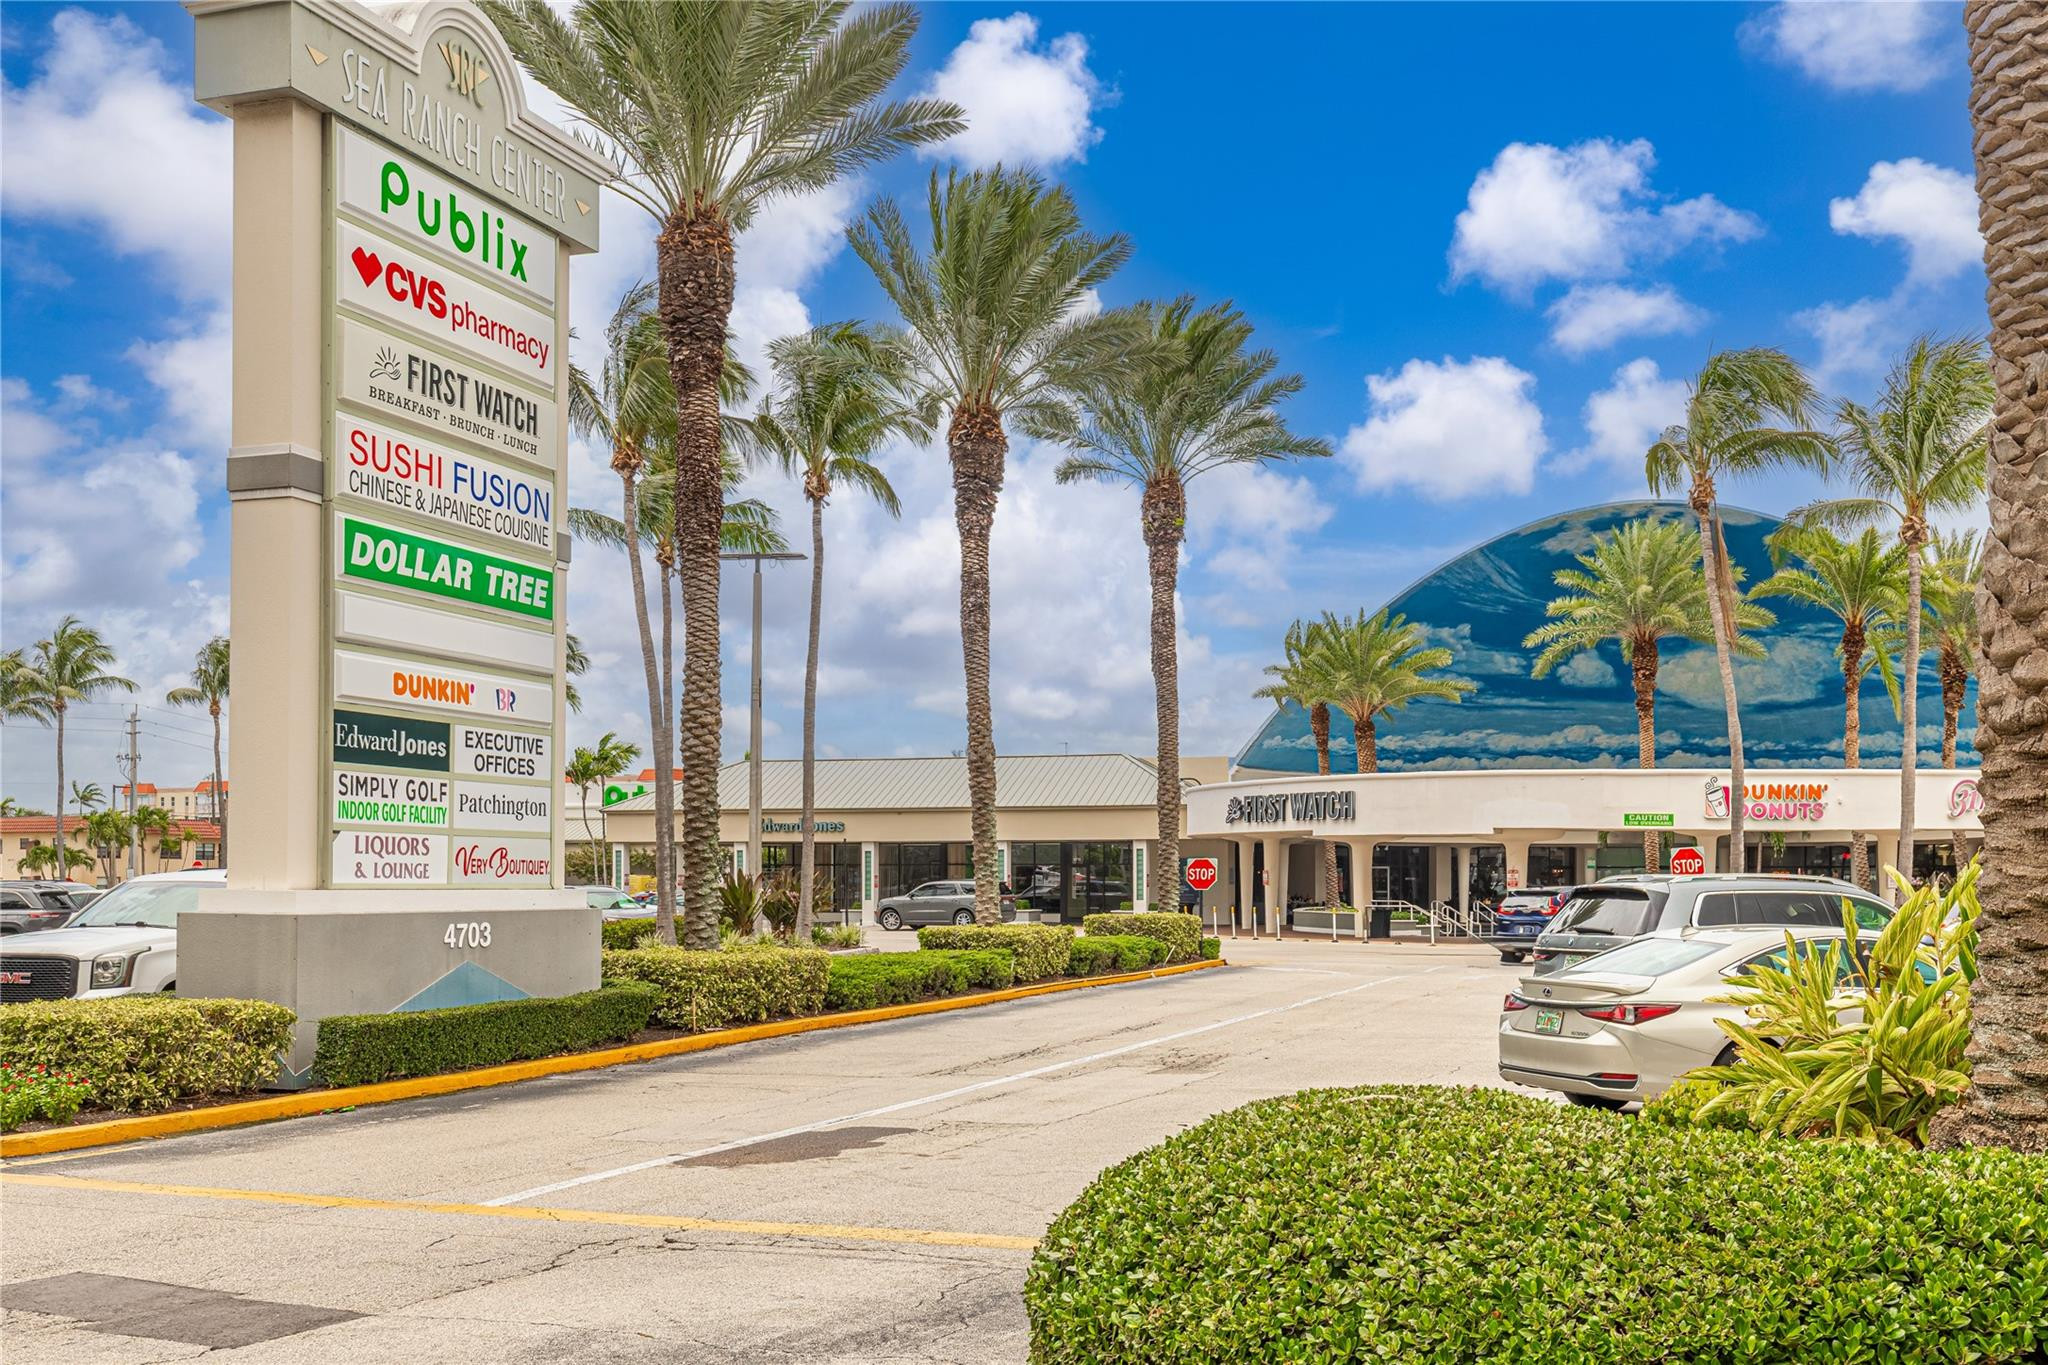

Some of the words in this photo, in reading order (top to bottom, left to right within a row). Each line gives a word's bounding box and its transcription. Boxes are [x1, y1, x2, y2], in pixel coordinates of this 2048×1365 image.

[342, 49, 388, 125] SEA
[402, 80, 481, 176] RANCH
[491, 135, 566, 223] CENTER
[381, 161, 528, 283] Publix
[385, 262, 447, 319] CVS
[451, 302, 549, 369] pharmacy
[407, 354, 469, 411] FIRST
[474, 380, 539, 438] WATCH
[369, 385, 440, 421] BREAKFAST
[450, 415, 495, 441] BRUNCH
[503, 433, 538, 455] LUNCH
[350, 430, 442, 489] SUSHI
[453, 461, 549, 522] FUSION
[349, 470, 412, 508] CHINESE
[415, 488, 426, 512] &
[429, 494, 492, 530] JAPANESE
[495, 513, 549, 547] COUISINE
[351, 532, 473, 591] DOLLAR
[485, 565, 549, 608] TREE
[393, 672, 475, 705] DUNKIN'
[496, 687, 516, 712] BR
[465, 730, 544, 756] EXECUTIVE
[474, 753, 535, 777] OFFICES
[338, 773, 398, 799] SIMPLY
[406, 779, 447, 803] GOLF
[338, 800, 379, 821] INDOOR
[382, 803, 407, 822] GOLF
[409, 805, 448, 825] FACILITY
[459, 793, 547, 821] Patchington
[1243, 794, 1288, 823] FIRST
[1290, 791, 1356, 821] WATCH
[814, 821, 845, 832] ones
[354, 835, 430, 859] LIQUORS
[355, 861, 368, 879] &
[374, 862, 430, 879] LOUNGE
[1188, 868, 1215, 880] STOP
[1673, 859, 1702, 873] STOP
[444, 922, 492, 949] 4703
[0, 972, 32, 984] MC
